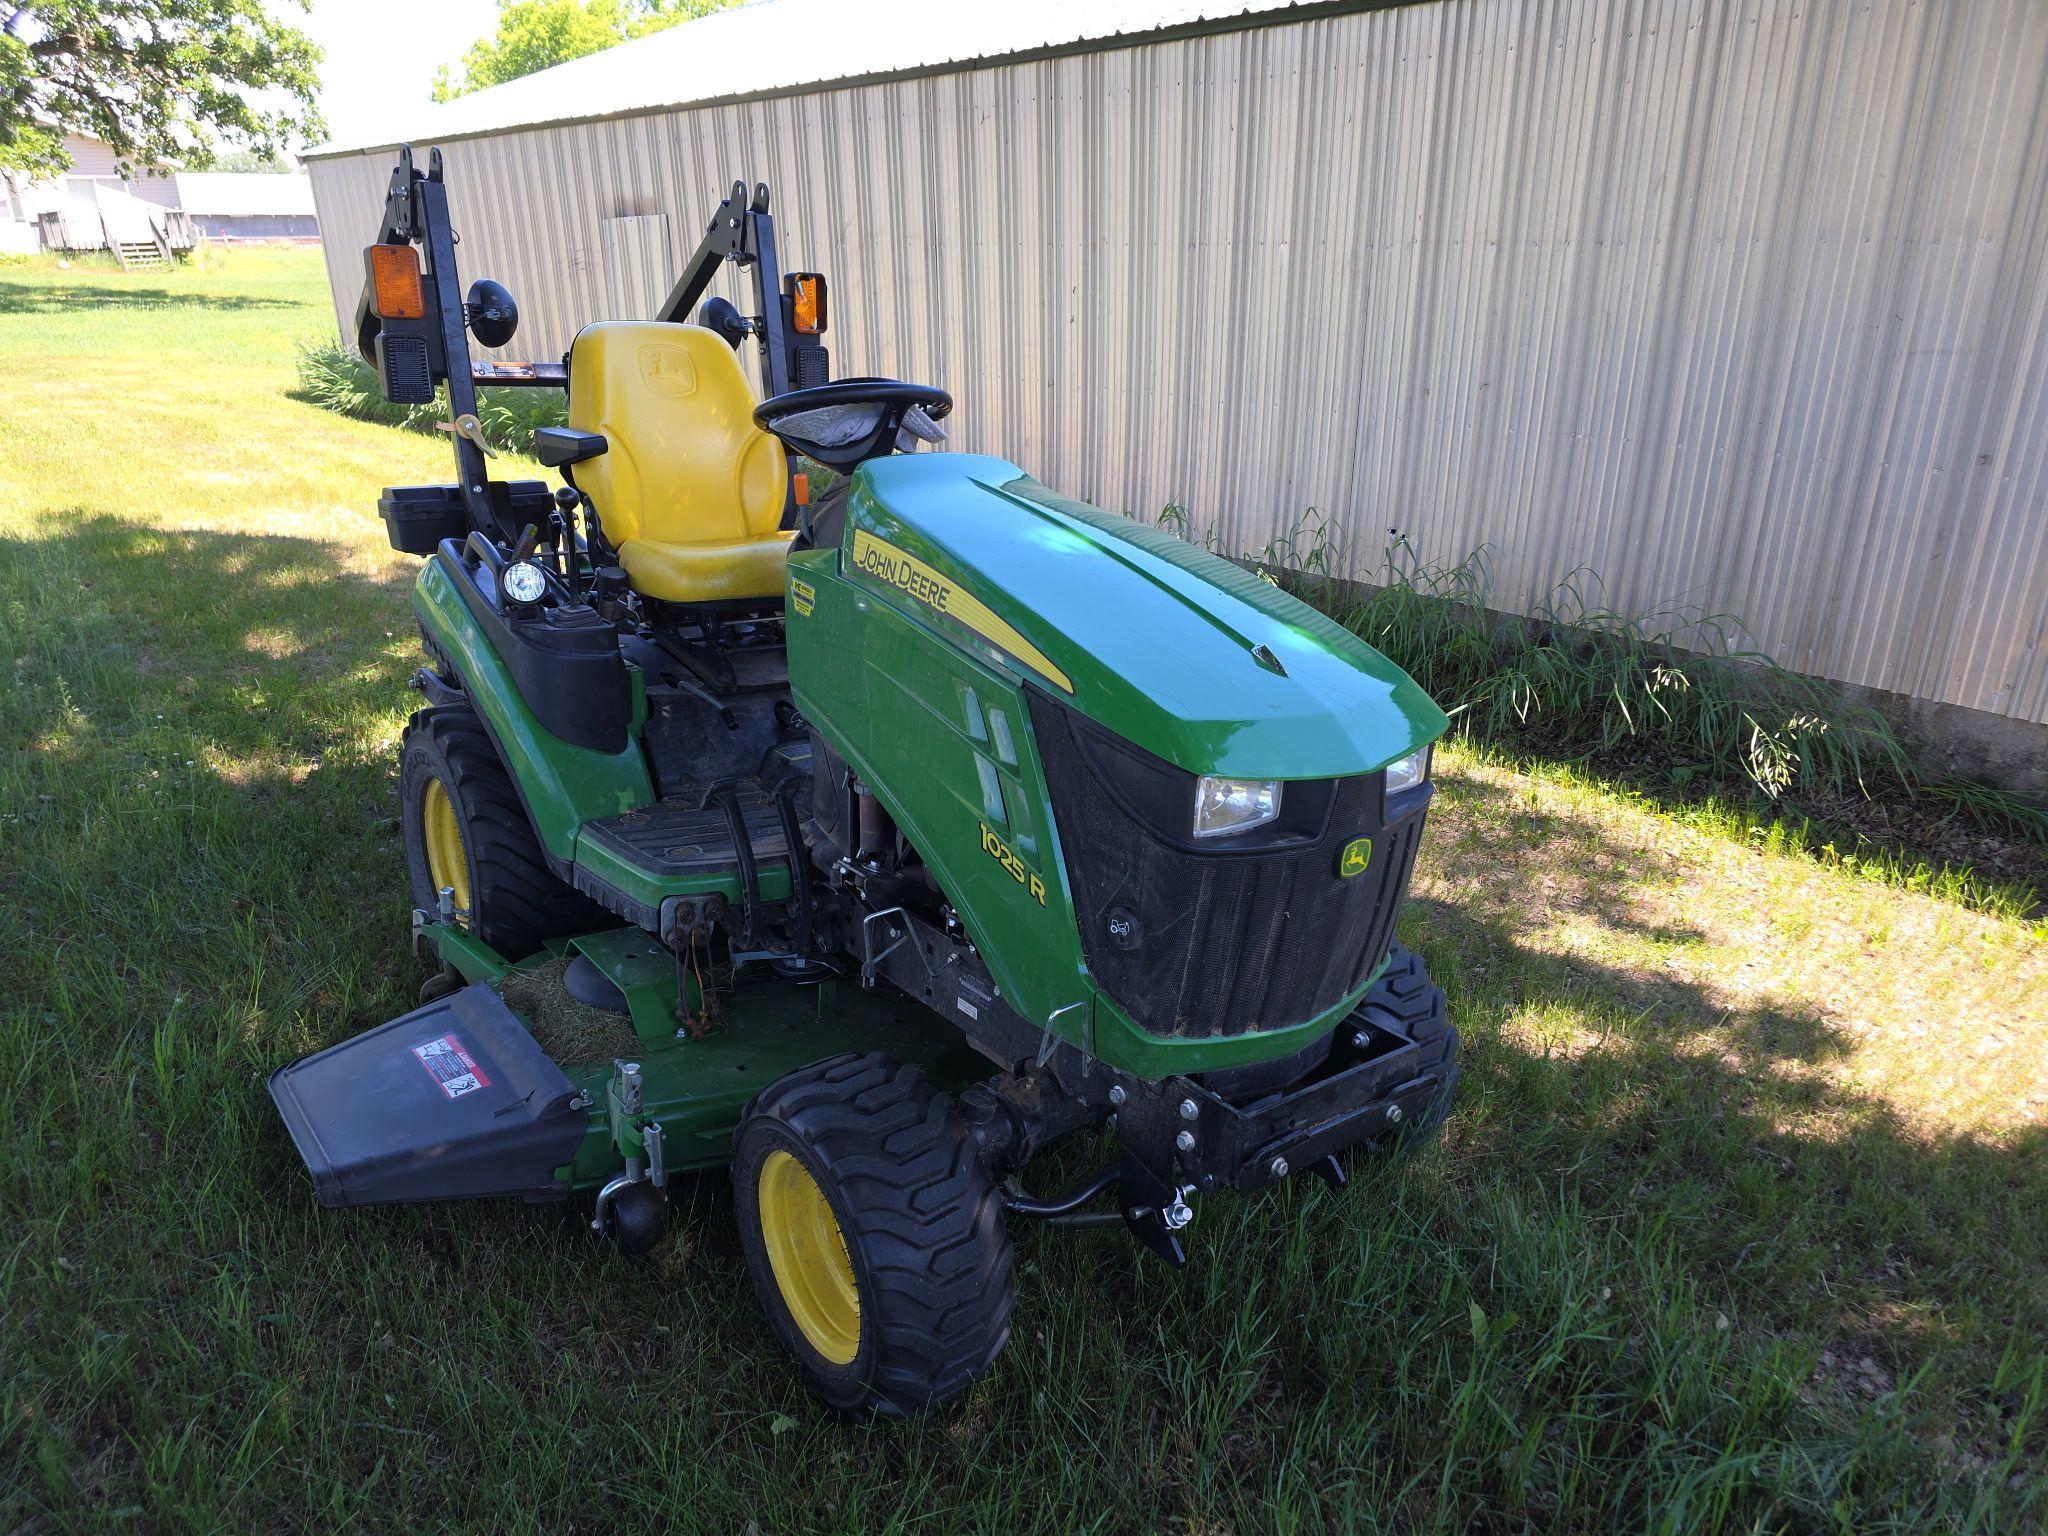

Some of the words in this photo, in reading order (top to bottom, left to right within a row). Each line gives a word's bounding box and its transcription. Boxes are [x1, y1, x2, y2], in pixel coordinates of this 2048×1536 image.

[858, 543, 897, 581] JOHN
[898, 559, 950, 610] DEERE
[979, 821, 1025, 884] 1025
[1029, 872, 1046, 908] R
